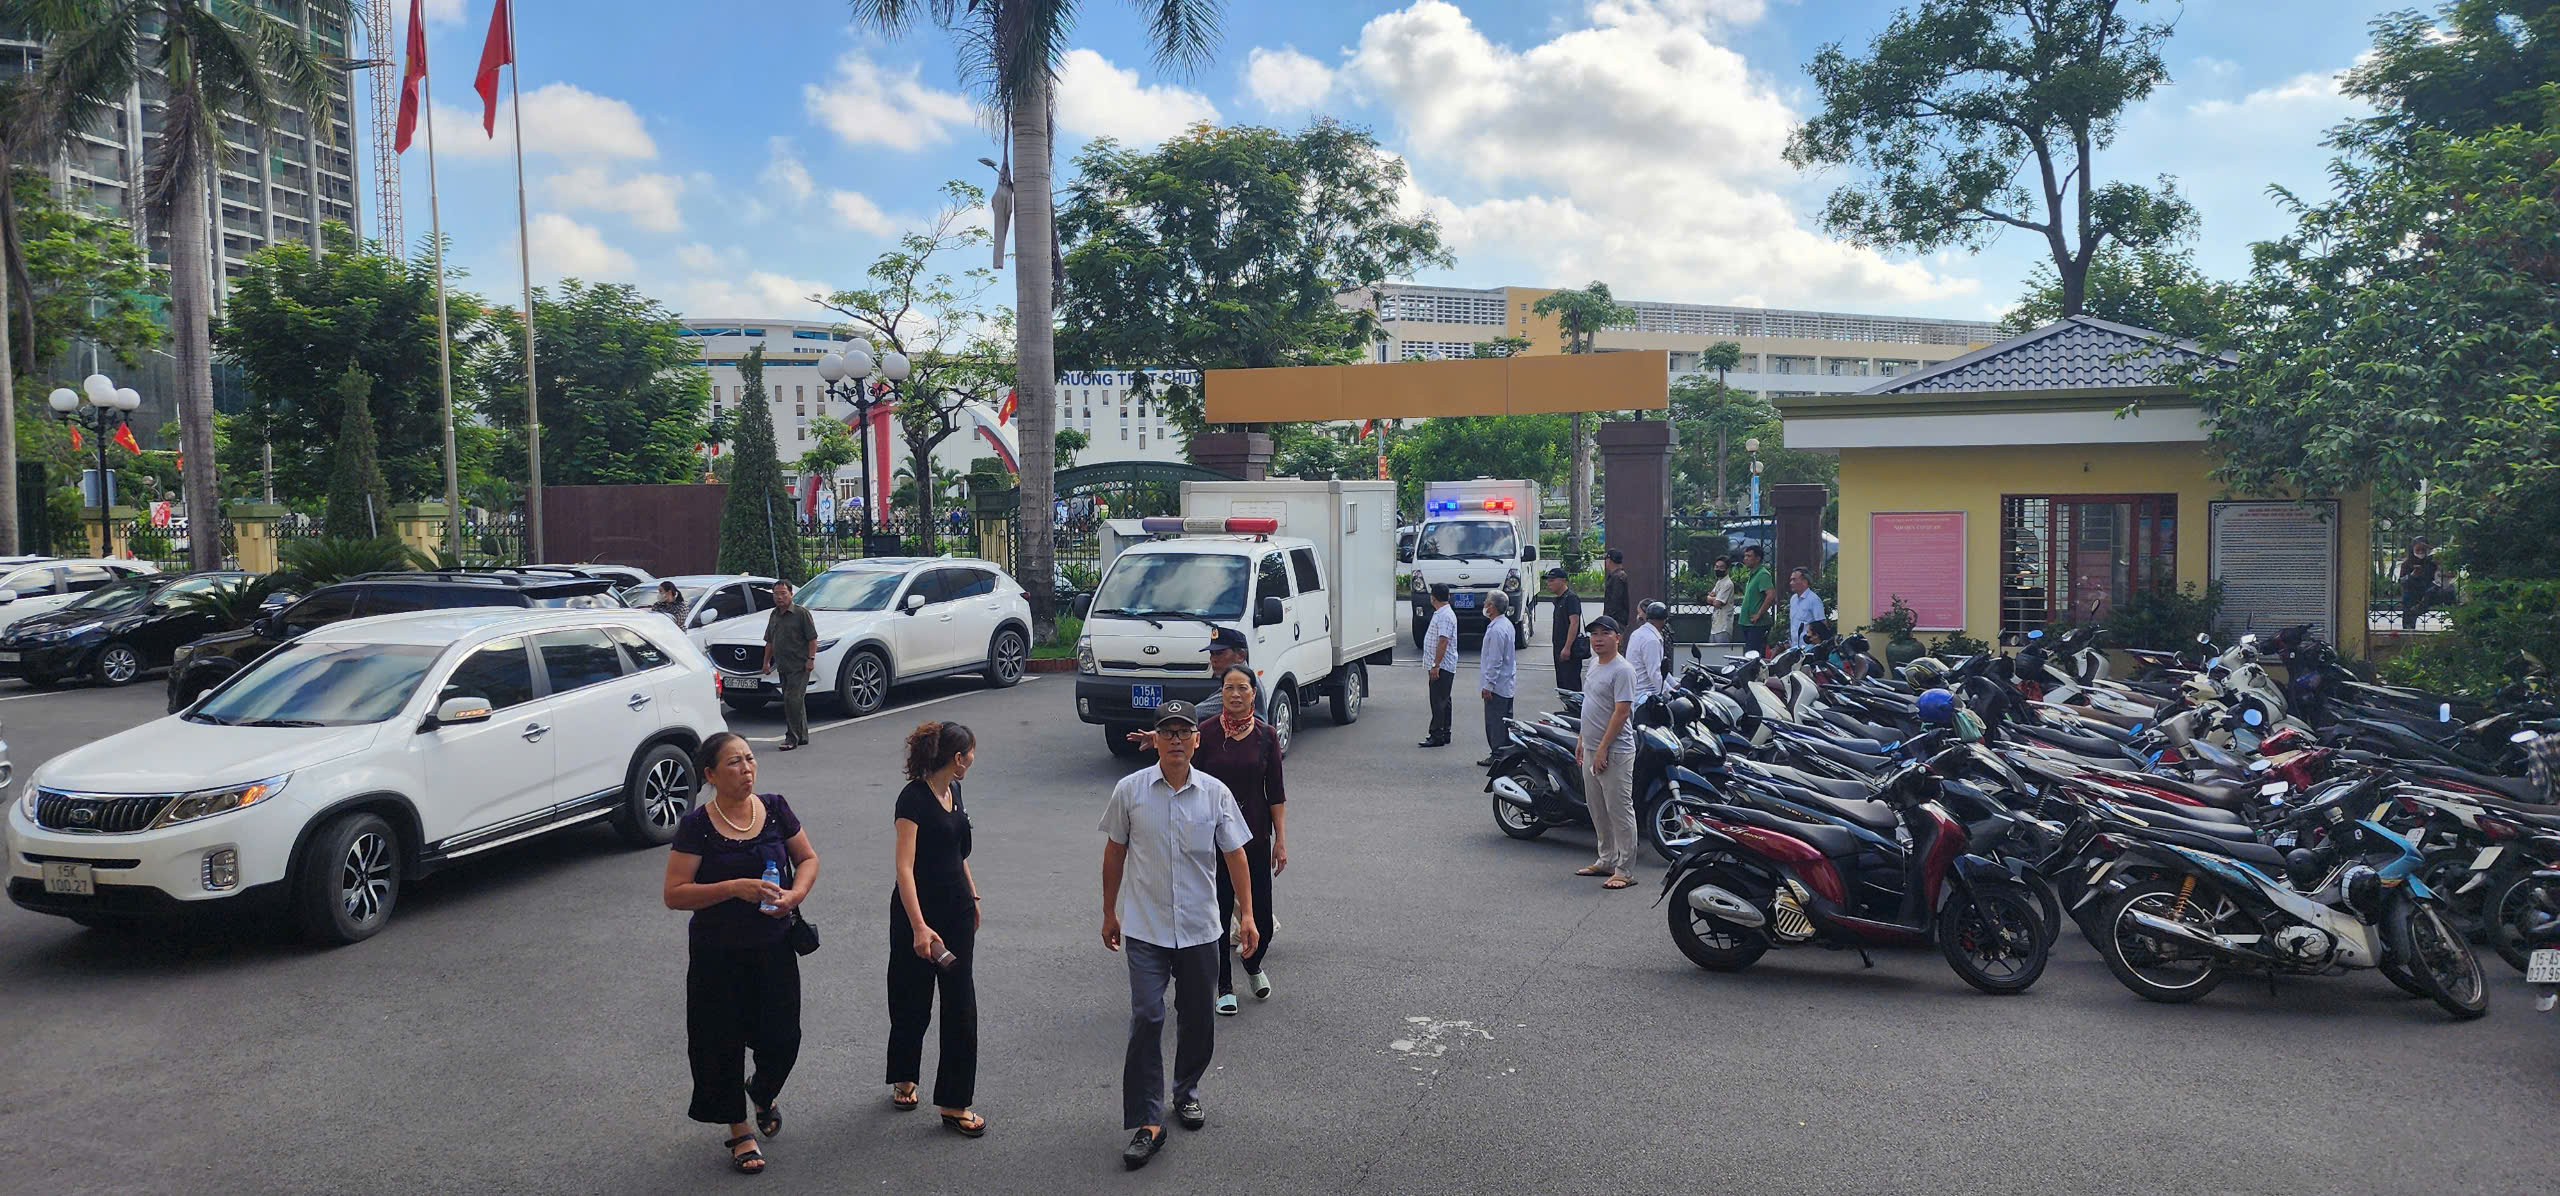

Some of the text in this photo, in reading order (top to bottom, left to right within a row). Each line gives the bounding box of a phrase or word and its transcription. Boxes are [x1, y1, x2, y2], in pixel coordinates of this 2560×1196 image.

[1117, 372, 1158, 386] THT
[1144, 646, 1158, 654] KIA
[1140, 686, 1156, 697] 15A
[1133, 695, 1162, 707] 008.12
